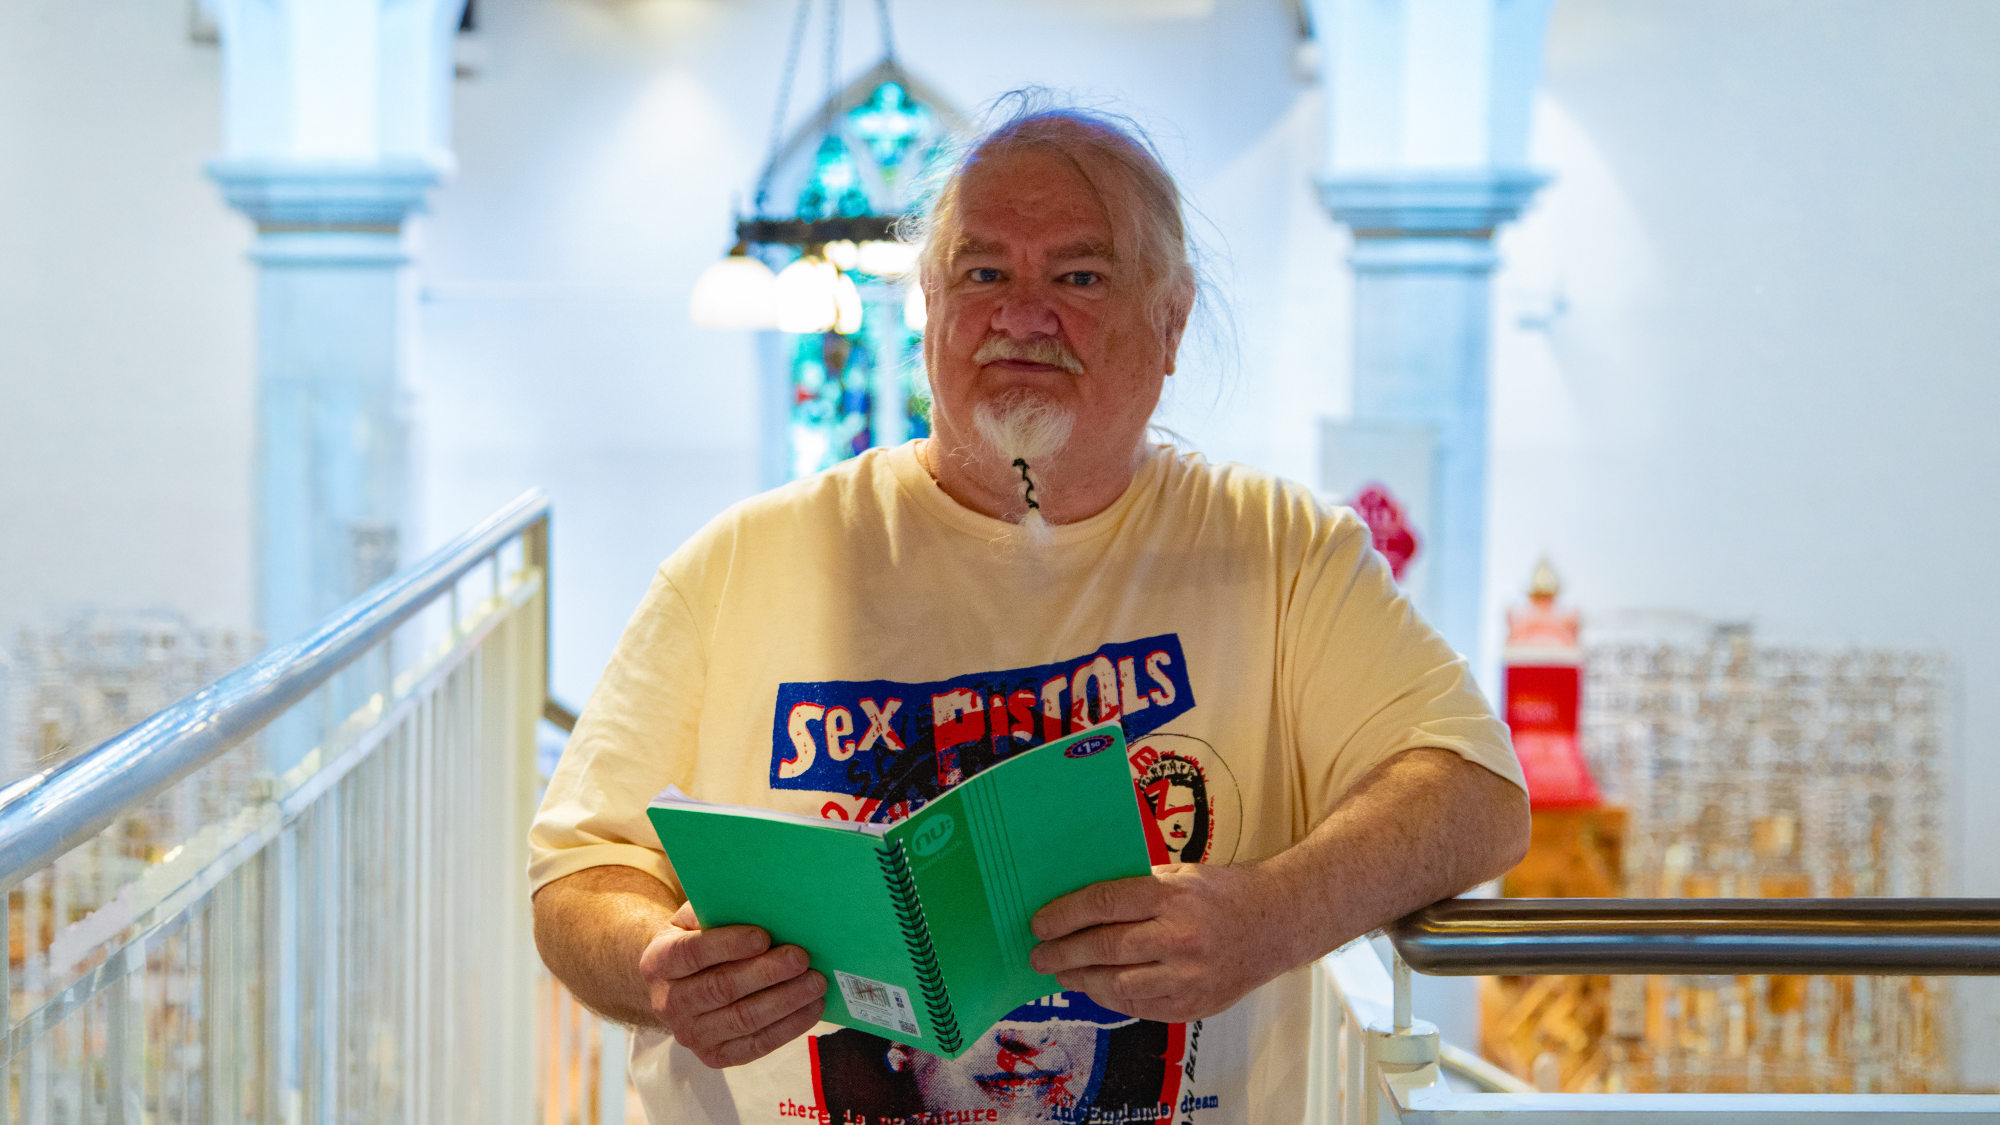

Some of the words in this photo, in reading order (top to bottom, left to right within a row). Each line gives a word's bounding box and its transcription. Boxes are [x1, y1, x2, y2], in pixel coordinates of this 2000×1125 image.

[779, 1098, 831, 1124] there
[912, 1107, 998, 1125] future
[1180, 1095, 1220, 1115] dream
